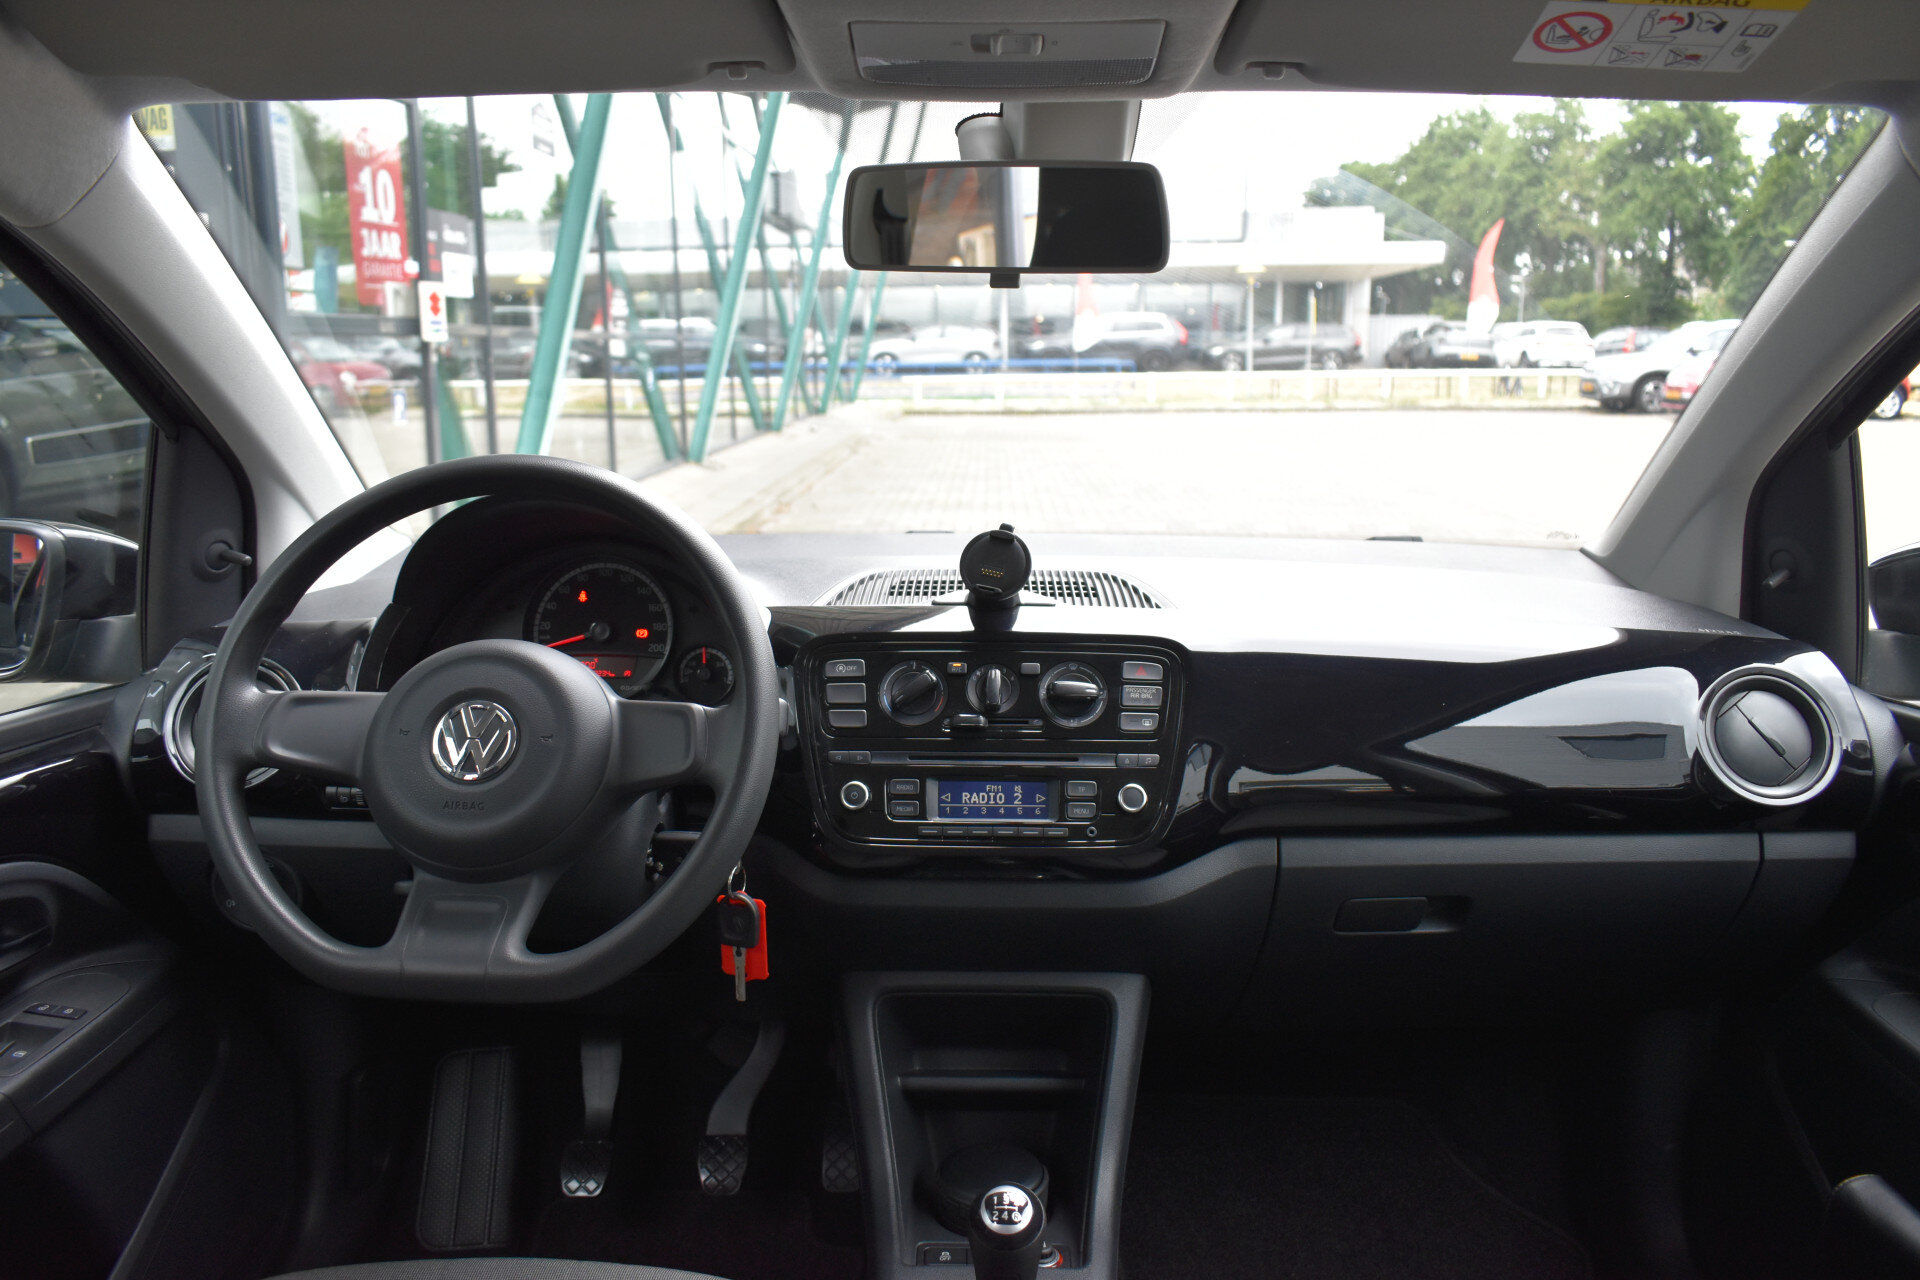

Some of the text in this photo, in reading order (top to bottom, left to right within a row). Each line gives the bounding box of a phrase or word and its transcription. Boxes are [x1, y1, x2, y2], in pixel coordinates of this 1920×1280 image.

[358, 165, 396, 225] 10
[360, 229, 402, 260] JAAR
[648, 643, 665, 653] 200
[986, 784, 1002, 793] FM1
[962, 792, 1022, 805] RADIO 2
[442, 800, 485, 811] AIRBAG
[945, 807, 1041, 815] 1 2 3 4 5 6
[992, 1196, 998, 1205] 1
[992, 1212, 999, 1221] 2
[1001, 1212, 1009, 1220] 4
